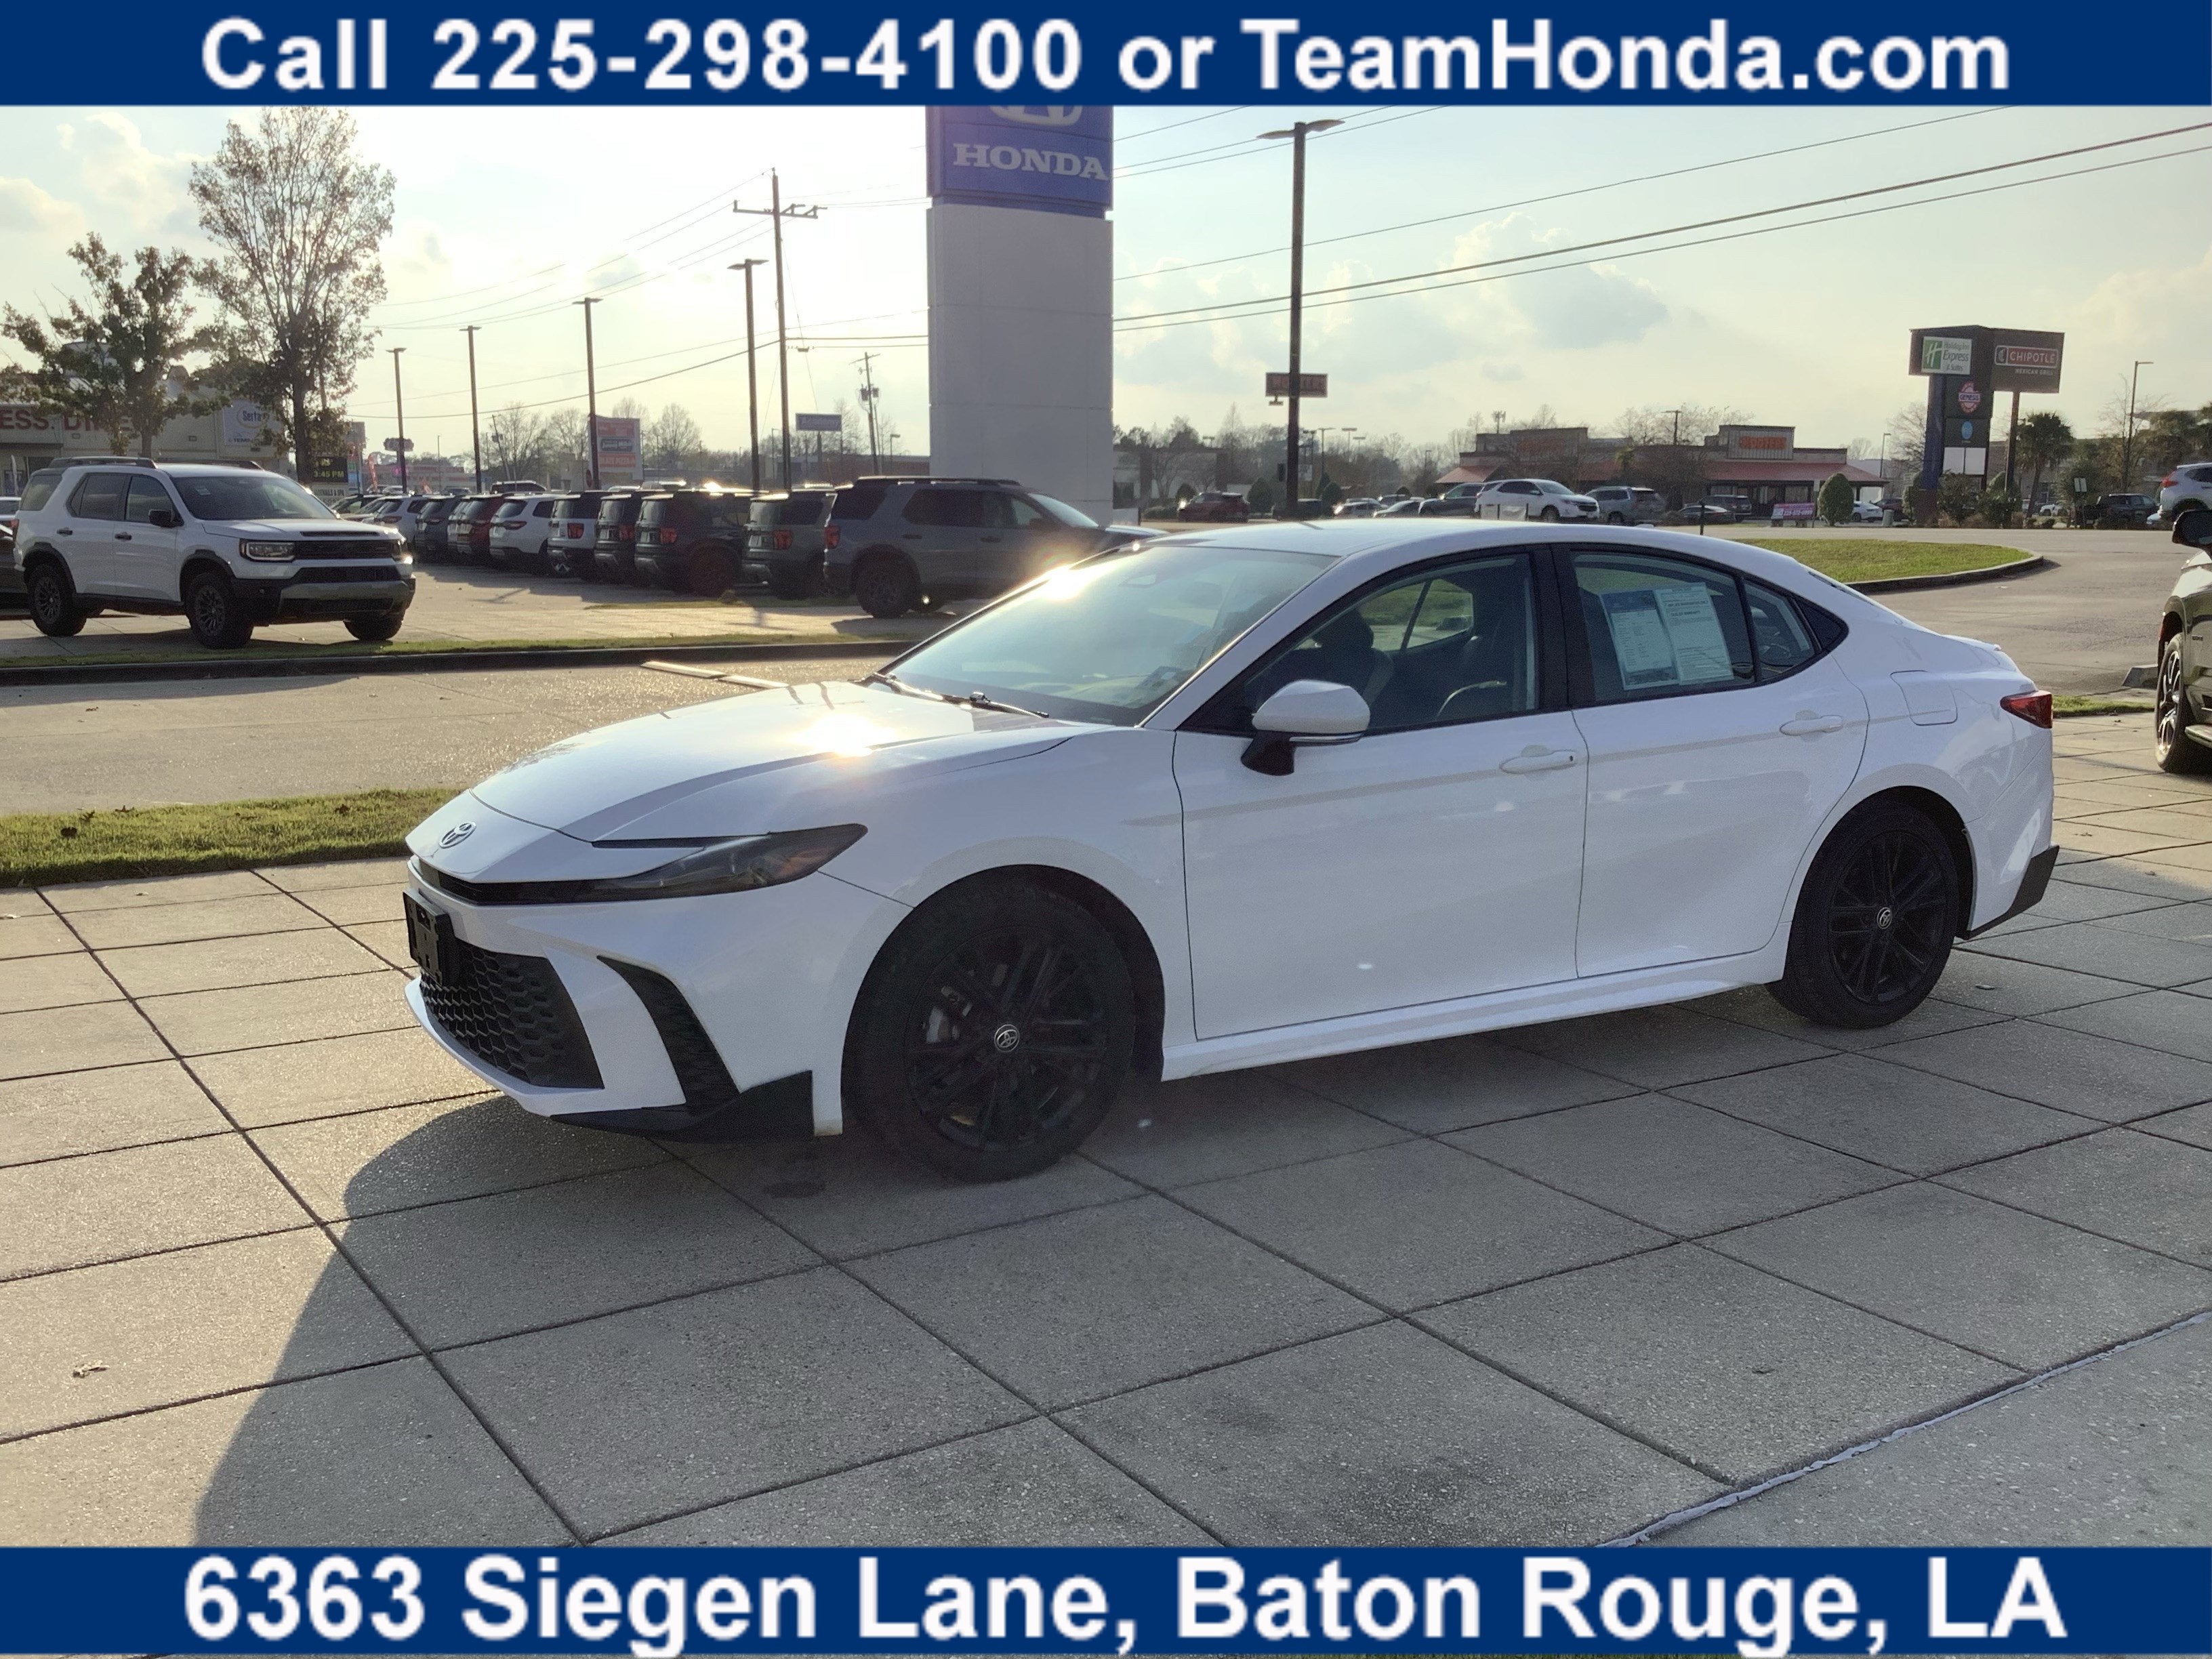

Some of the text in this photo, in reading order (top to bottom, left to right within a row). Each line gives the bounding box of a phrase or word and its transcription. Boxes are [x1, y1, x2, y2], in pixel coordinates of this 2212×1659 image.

[953, 143, 1109, 181] HONDA
[1943, 350, 1969, 363] Express
[2009, 351, 2056, 363] CHIPOTLE
[242, 410, 262, 422] Serta
